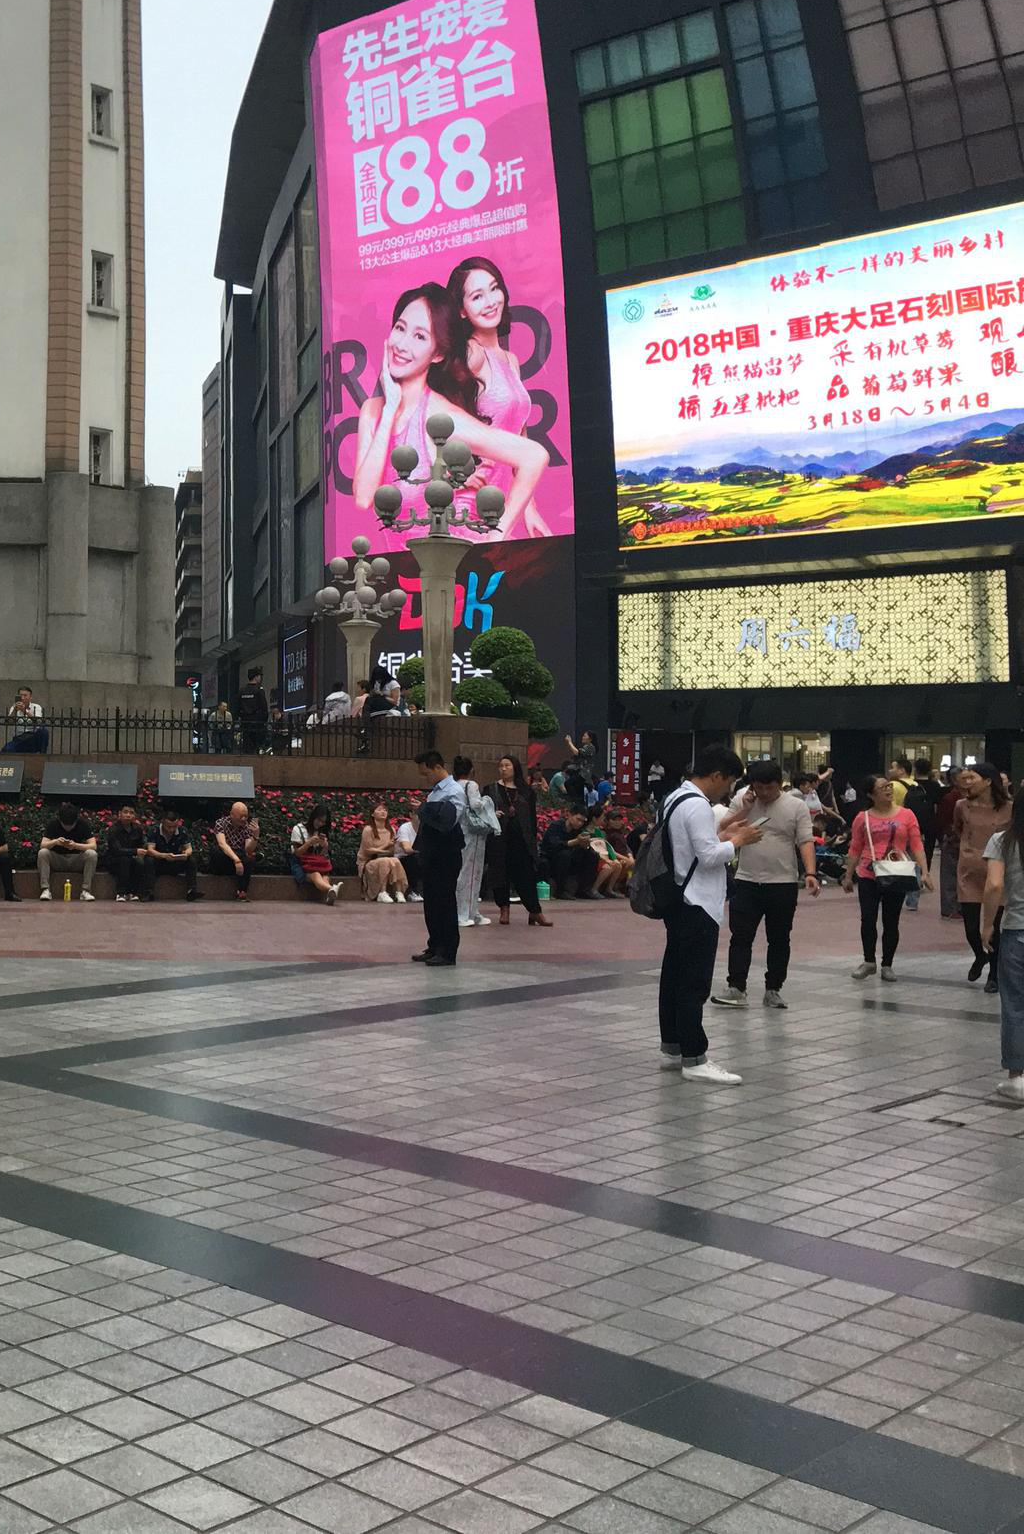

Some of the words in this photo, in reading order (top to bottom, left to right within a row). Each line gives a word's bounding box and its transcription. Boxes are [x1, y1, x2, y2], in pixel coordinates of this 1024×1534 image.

[345, 40, 516, 143] 铜雀台
[770, 230, 1004, 292] 体验不一样的美丽乡村
[736, 615, 862, 656] 周六福
